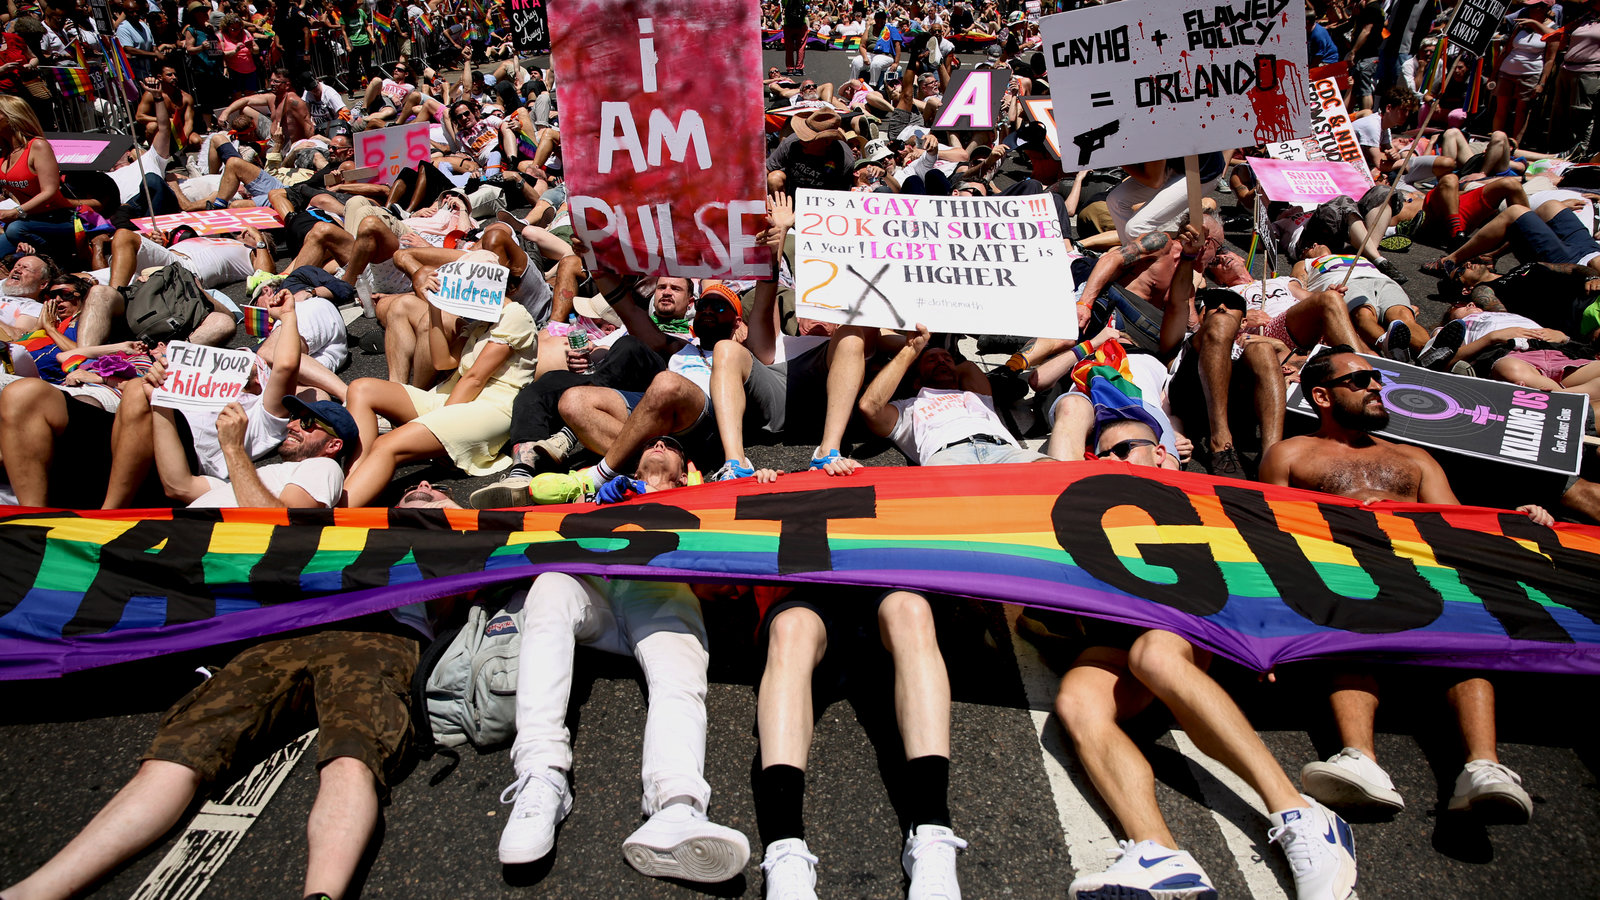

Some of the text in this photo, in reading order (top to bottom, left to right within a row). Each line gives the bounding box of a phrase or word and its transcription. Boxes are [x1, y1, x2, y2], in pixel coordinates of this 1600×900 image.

[1183, 0, 1290, 31] FLAWED
[1460, 5, 1485, 28] TO GO
[1186, 20, 1277, 51] POLICY
[1451, 21, 1480, 45] AWAY!
[1134, 54, 1277, 108] ORLANDO
[936, 71, 993, 127] A
[1314, 79, 1341, 109] CDC
[1334, 129, 1361, 162] NIH
[598, 101, 713, 173] AM
[806, 196, 836, 207] IT'S
[846, 198, 856, 208] A
[570, 195, 773, 278] PULSE
[801, 212, 1063, 240] 20K GUN SUICIDES
[803, 241, 813, 251] A
[870, 241, 942, 261] LGBT
[949, 243, 1029, 263] RATE
[1038, 246, 1054, 258] is
[466, 263, 505, 282] YOUR
[903, 264, 1017, 287] HIGHER
[210, 352, 250, 374] YOUR
[1500, 390, 1550, 462] KILLING US
